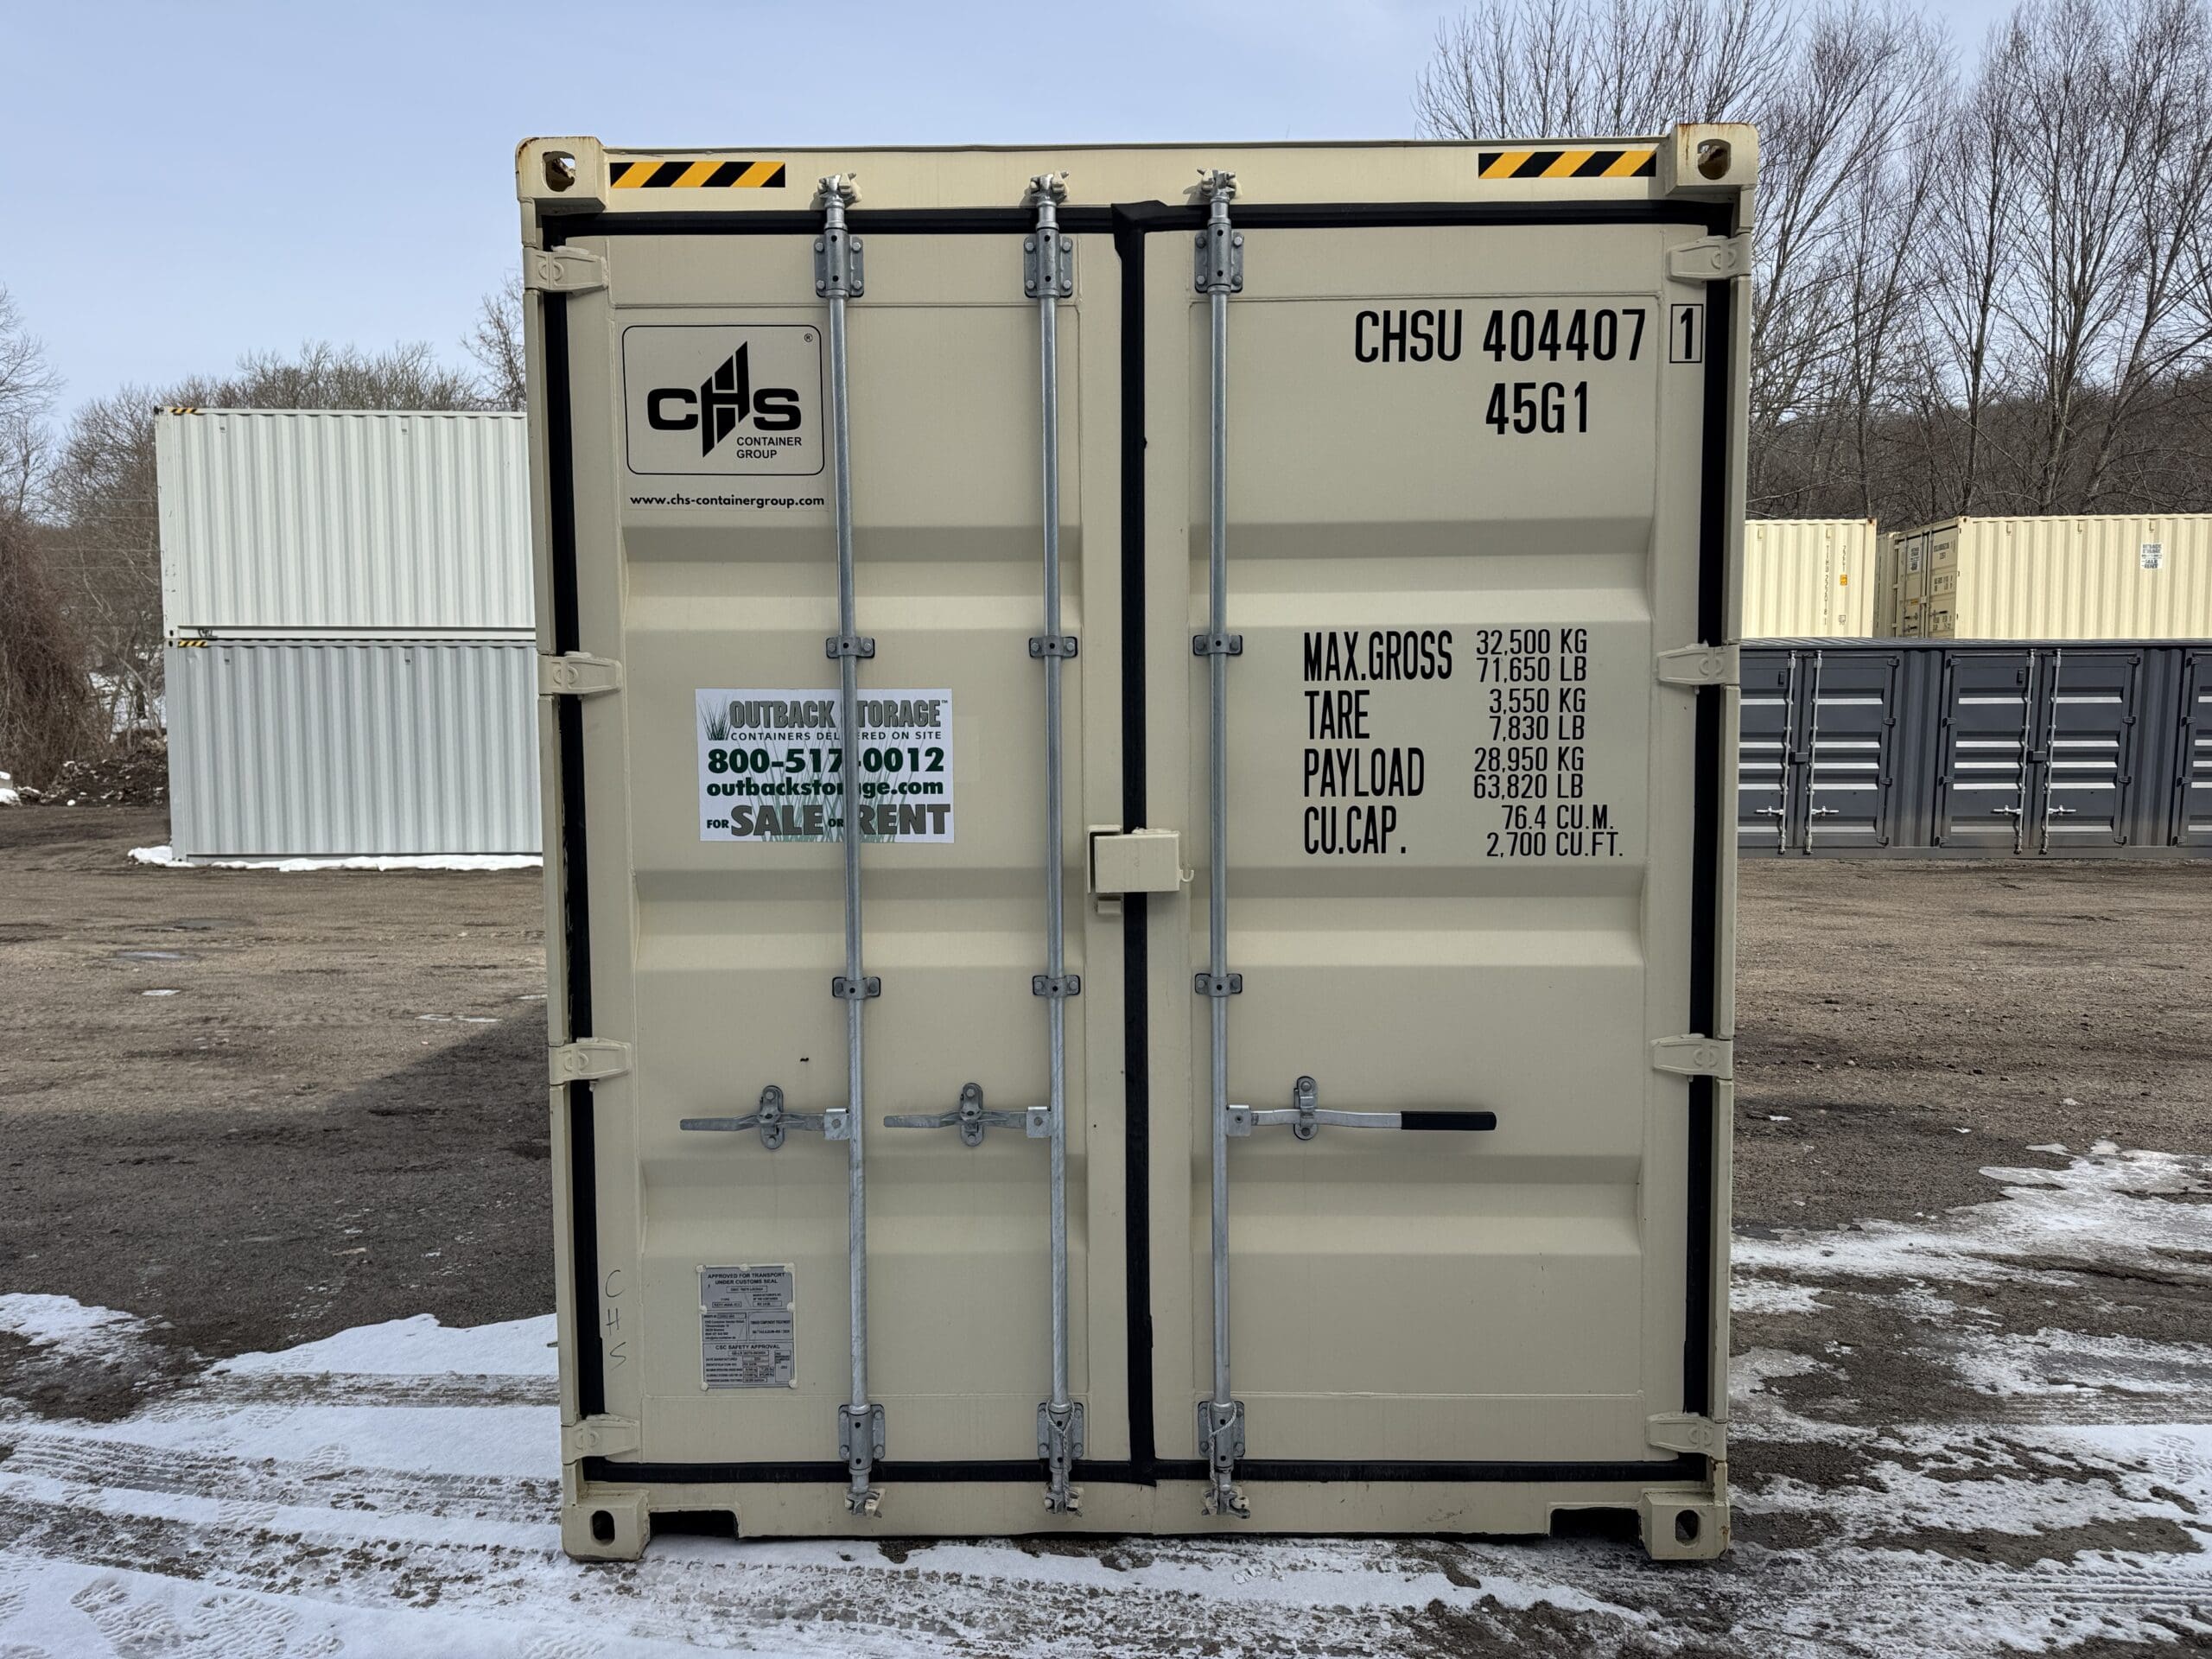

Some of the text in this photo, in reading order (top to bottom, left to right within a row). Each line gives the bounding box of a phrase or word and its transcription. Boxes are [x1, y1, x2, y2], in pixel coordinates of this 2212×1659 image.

[1355, 307, 1694, 363] CHSU 404407 1
[647, 340, 802, 458] CHS
[1485, 381, 1588, 435] 45G1
[736, 436, 803, 447] CONTAINER
[736, 448, 778, 459] GROUP
[630, 493, 825, 509] www.chs-containergroup.com
[1304, 628, 1587, 682] MAX.GROSS 32,500 KG
[1476, 656, 1587, 683] 71,650 LB
[729, 699, 942, 728] OUTBACK TORAGE
[1304, 688, 1586, 740] TARE 3,550 KG
[730, 732, 811, 741] CONTAINERS
[892, 731, 910, 740] ON
[915, 731, 942, 740] SITE
[1489, 715, 1585, 742] 7,830 LB
[708, 747, 944, 773] 800-5170012
[1304, 747, 1585, 798] PAYLOAD 28,950 KG
[706, 777, 944, 799] outbackstorge.com
[1473, 773, 1584, 800] 63,820 LB
[706, 803, 951, 837] FOR SALE OR RENT
[1501, 805, 1547, 830] 76.4
[1556, 804, 1614, 830] CU.M.
[1486, 831, 1624, 858] 2,700 CU.FT.
